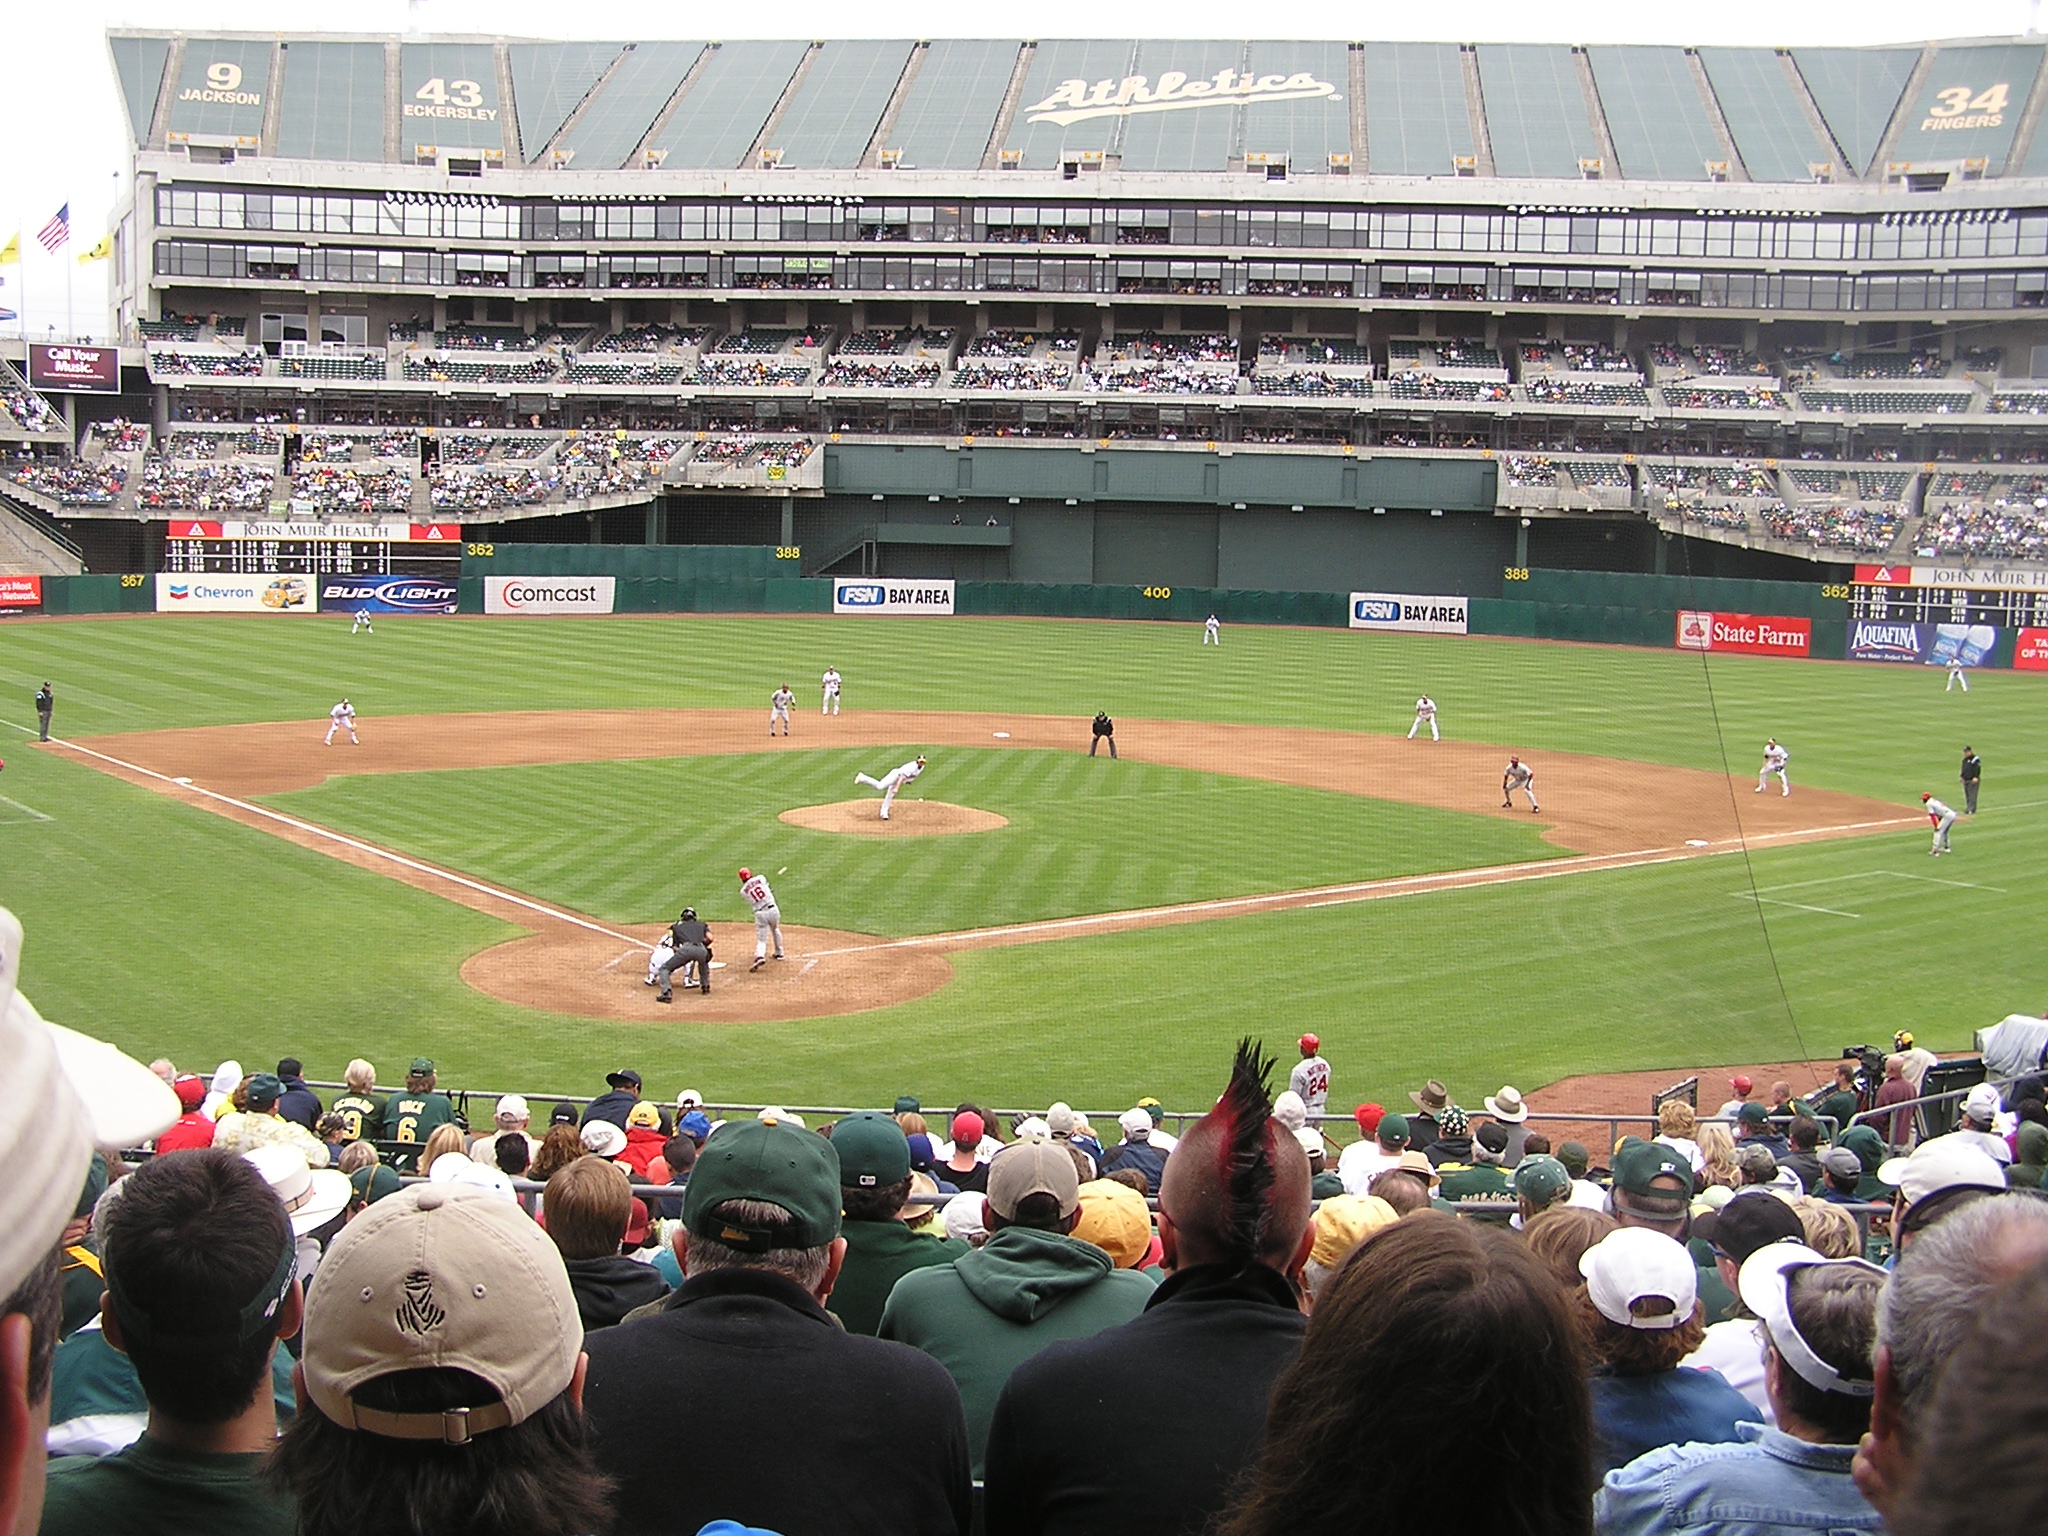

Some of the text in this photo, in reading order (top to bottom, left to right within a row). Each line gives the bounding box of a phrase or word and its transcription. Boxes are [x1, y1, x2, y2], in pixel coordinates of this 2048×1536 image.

[207, 62, 242, 90] 9
[179, 87, 260, 106] JACKSON
[415, 78, 483, 108] 43
[1024, 68, 1336, 124] Athletics
[1930, 83, 2009, 117] 34
[404, 104, 497, 122] ECKERSLEY
[1920, 114, 2003, 131] FINGERS
[48, 348, 100, 362] Call Your
[244, 525, 388, 537] JOHN MUIR HEALTH
[467, 544, 494, 557] 362
[776, 546, 800, 559] 388
[121, 575, 145, 587] 367
[1504, 568, 1529, 581] 388
[1933, 569, 2048, 585] JOHN MUIR H
[194, 585, 254, 599] Chevron
[323, 586, 457, 600] BUD LIGHT
[506, 583, 596, 605] comcast
[843, 586, 950, 605] FSN BAY AREA
[1143, 586, 1171, 599] 400
[1821, 585, 1849, 599] 362
[1360, 601, 1465, 623] FSN BAY AREA
[1713, 622, 1804, 646] State Farm
[1851, 621, 1919, 653] AQUAFINA
[2021, 648, 2036, 658] OF
[750, 886, 766, 902] 16
[1309, 1074, 1328, 1096] 24
[397, 1117, 417, 1143] 6
